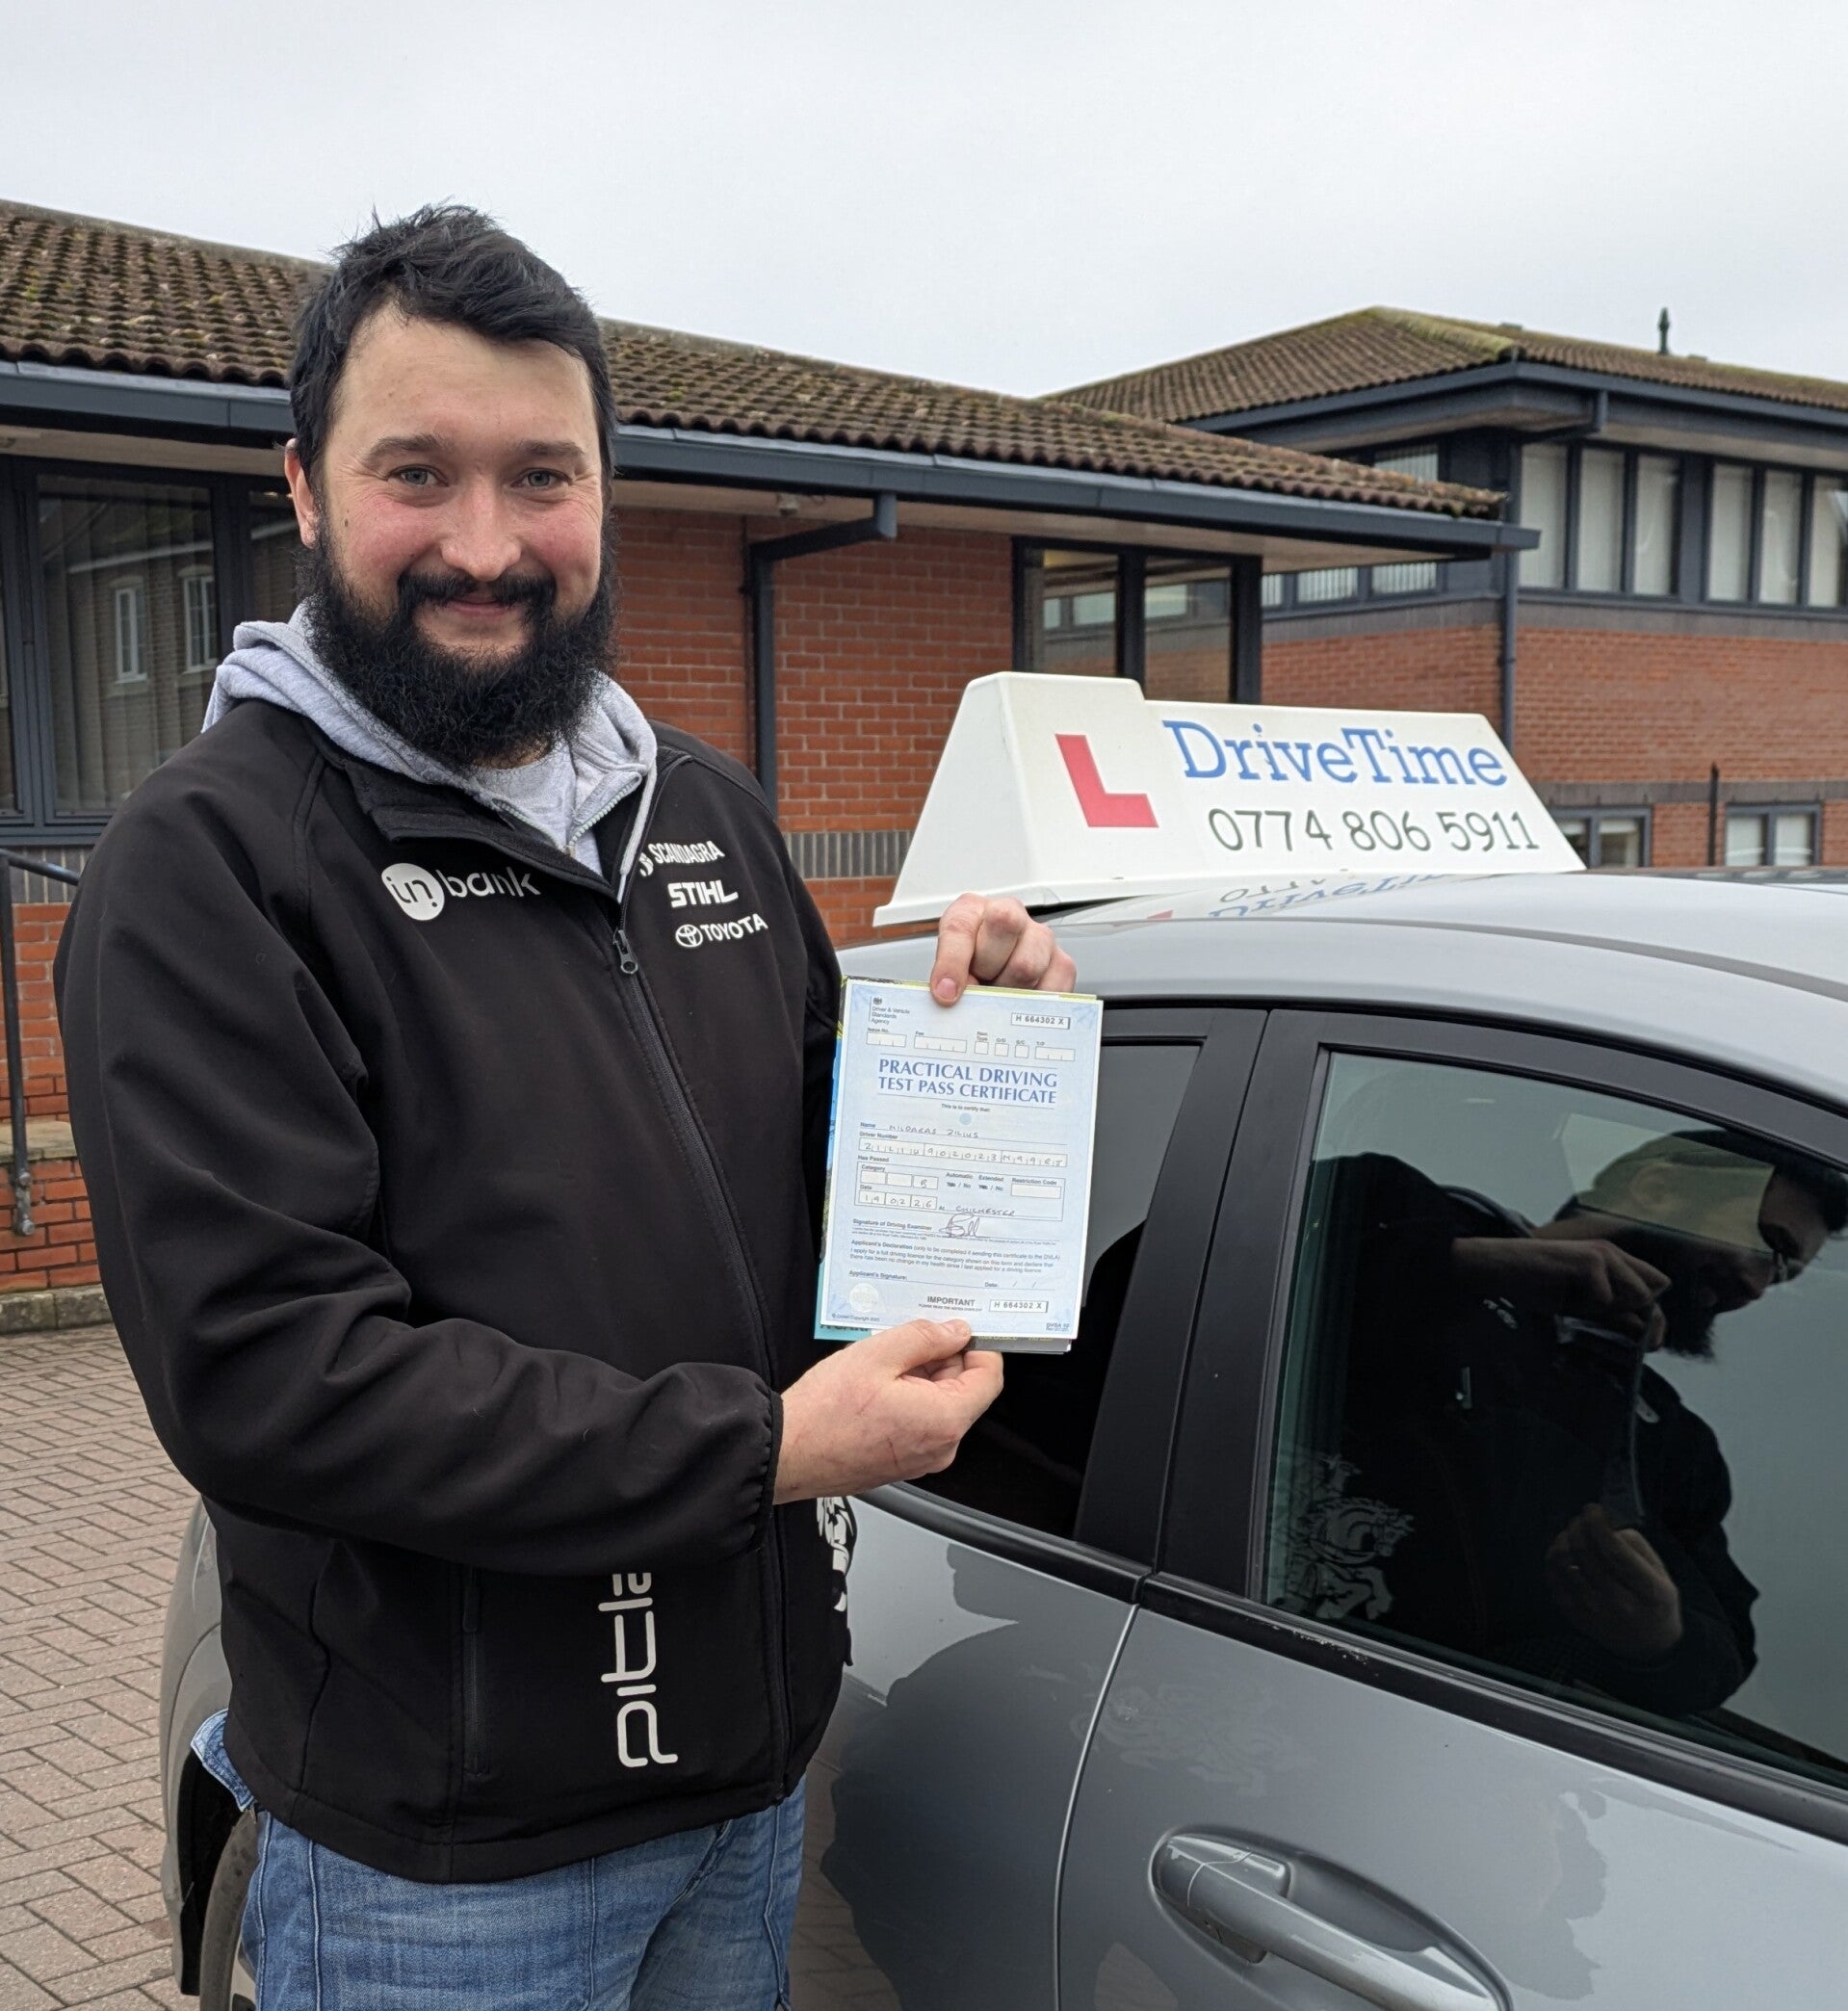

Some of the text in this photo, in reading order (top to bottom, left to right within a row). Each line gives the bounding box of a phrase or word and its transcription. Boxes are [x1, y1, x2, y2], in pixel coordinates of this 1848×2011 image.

[1161, 720, 1508, 787] DriveTime
[1054, 733, 1159, 828] L
[1209, 808, 1540, 852] 0774 806 5911
[650, 840, 725, 866] SCANDAGRA
[666, 879, 739, 907] STIHL
[699, 912, 768, 942] TOYOTA
[1025, 1014, 1055, 1024] 664302
[879, 1058, 1057, 1087] PRACTICAL DRIVING
[878, 1076, 1056, 1104] TEST PASS CERTIFICATE
[927, 1296, 976, 1306] IMPORTANT
